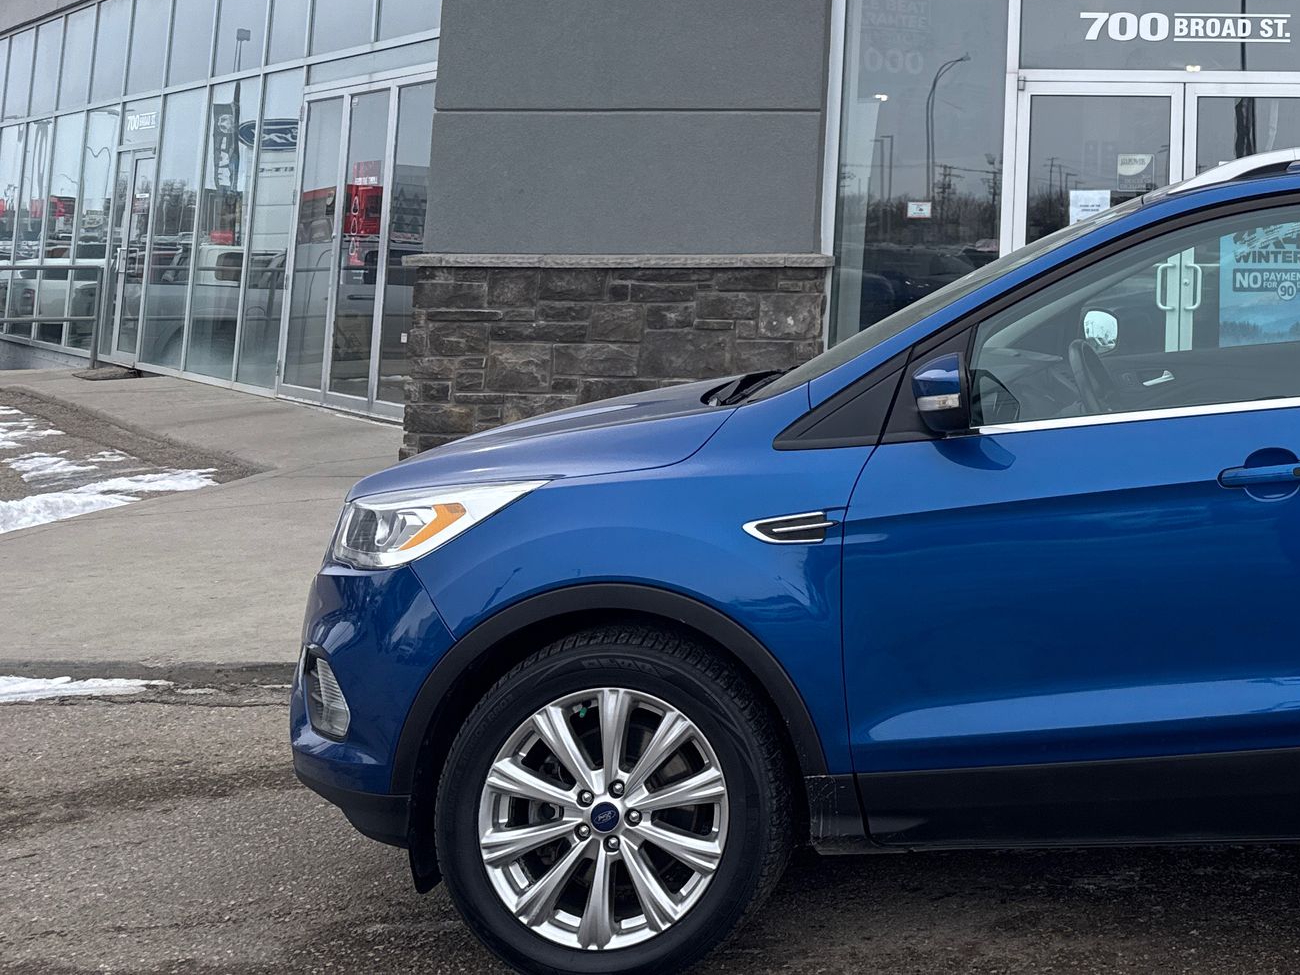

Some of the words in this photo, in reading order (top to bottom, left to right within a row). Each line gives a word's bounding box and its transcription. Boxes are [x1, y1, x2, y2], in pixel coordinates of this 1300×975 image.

[1080, 12, 1169, 41] 700
[1174, 18, 1251, 37] BROAD
[1260, 18, 1291, 37] ST.
[1235, 272, 1262, 288] NO
[1280, 285, 1295, 297] 90
